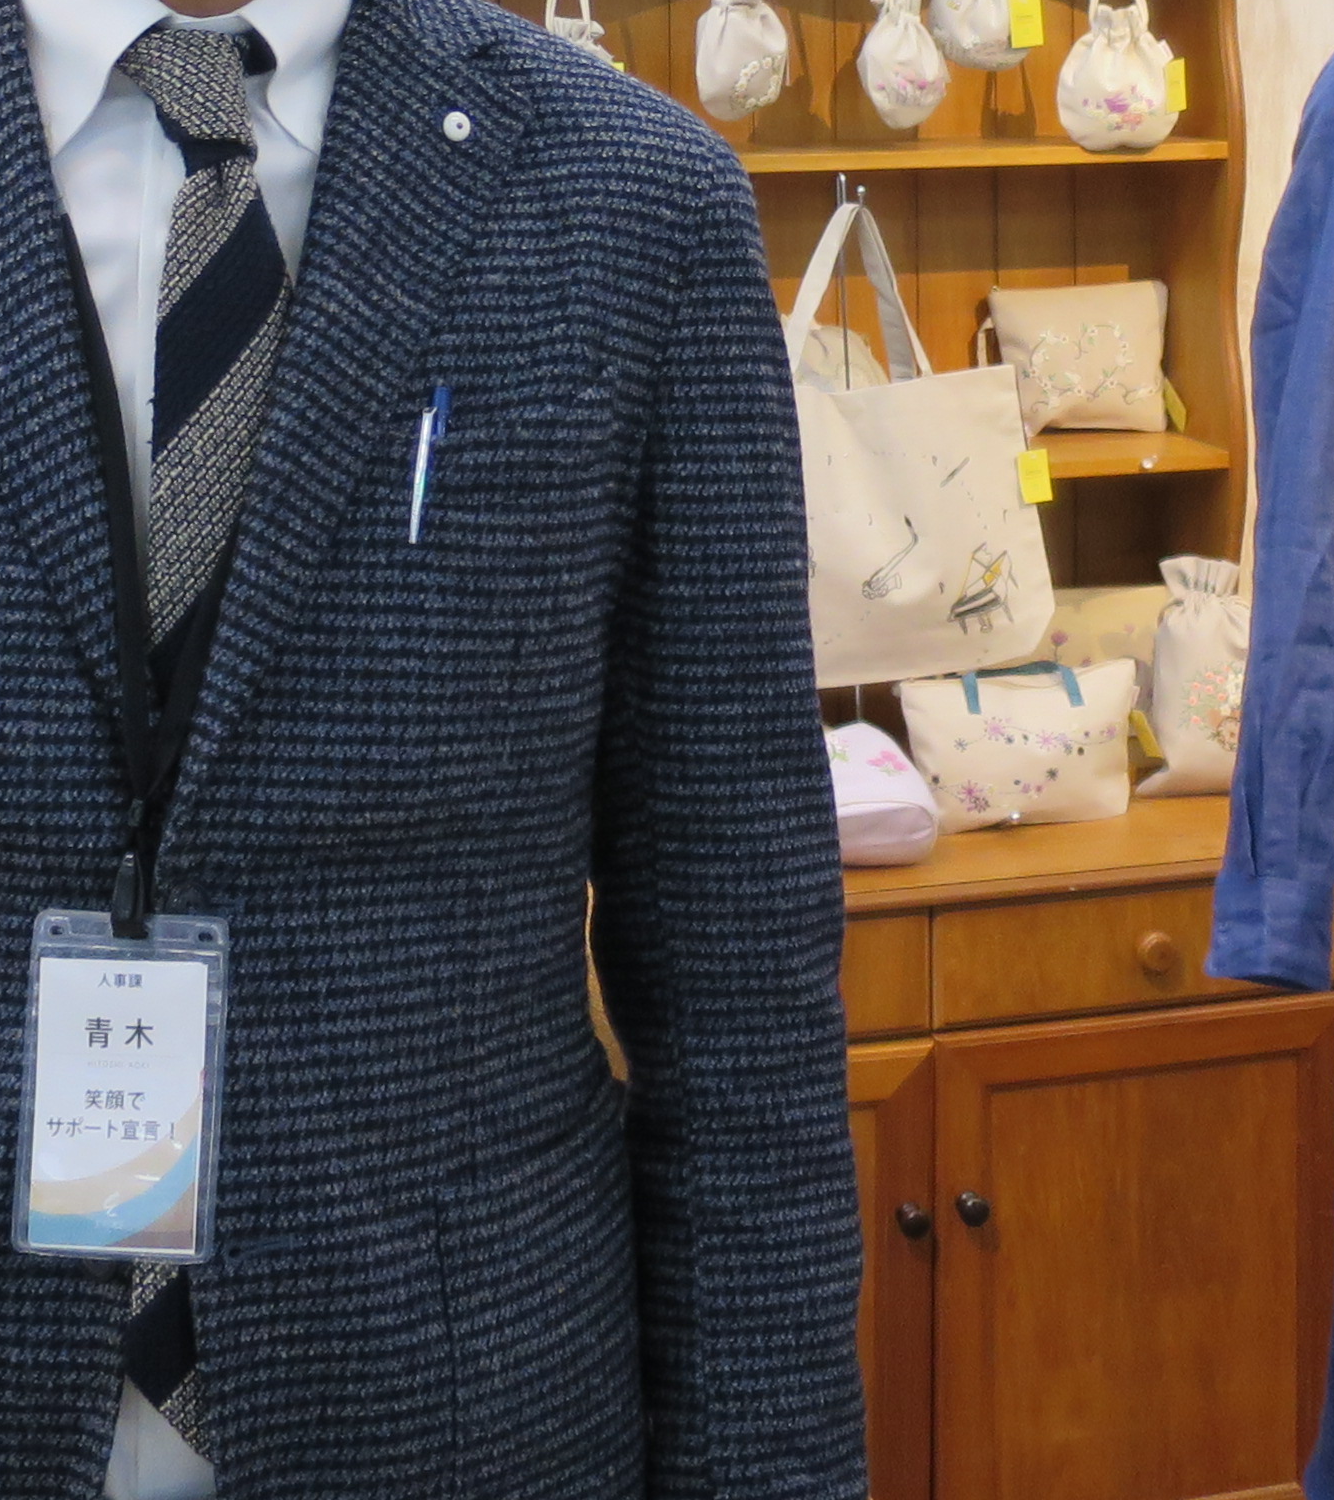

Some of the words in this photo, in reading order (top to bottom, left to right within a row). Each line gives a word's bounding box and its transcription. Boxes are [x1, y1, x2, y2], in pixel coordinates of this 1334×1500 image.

[98, 973, 143, 988] 人事課
[84, 1017, 154, 1049] 青木
[84, 1089, 146, 1111] 笑顔で
